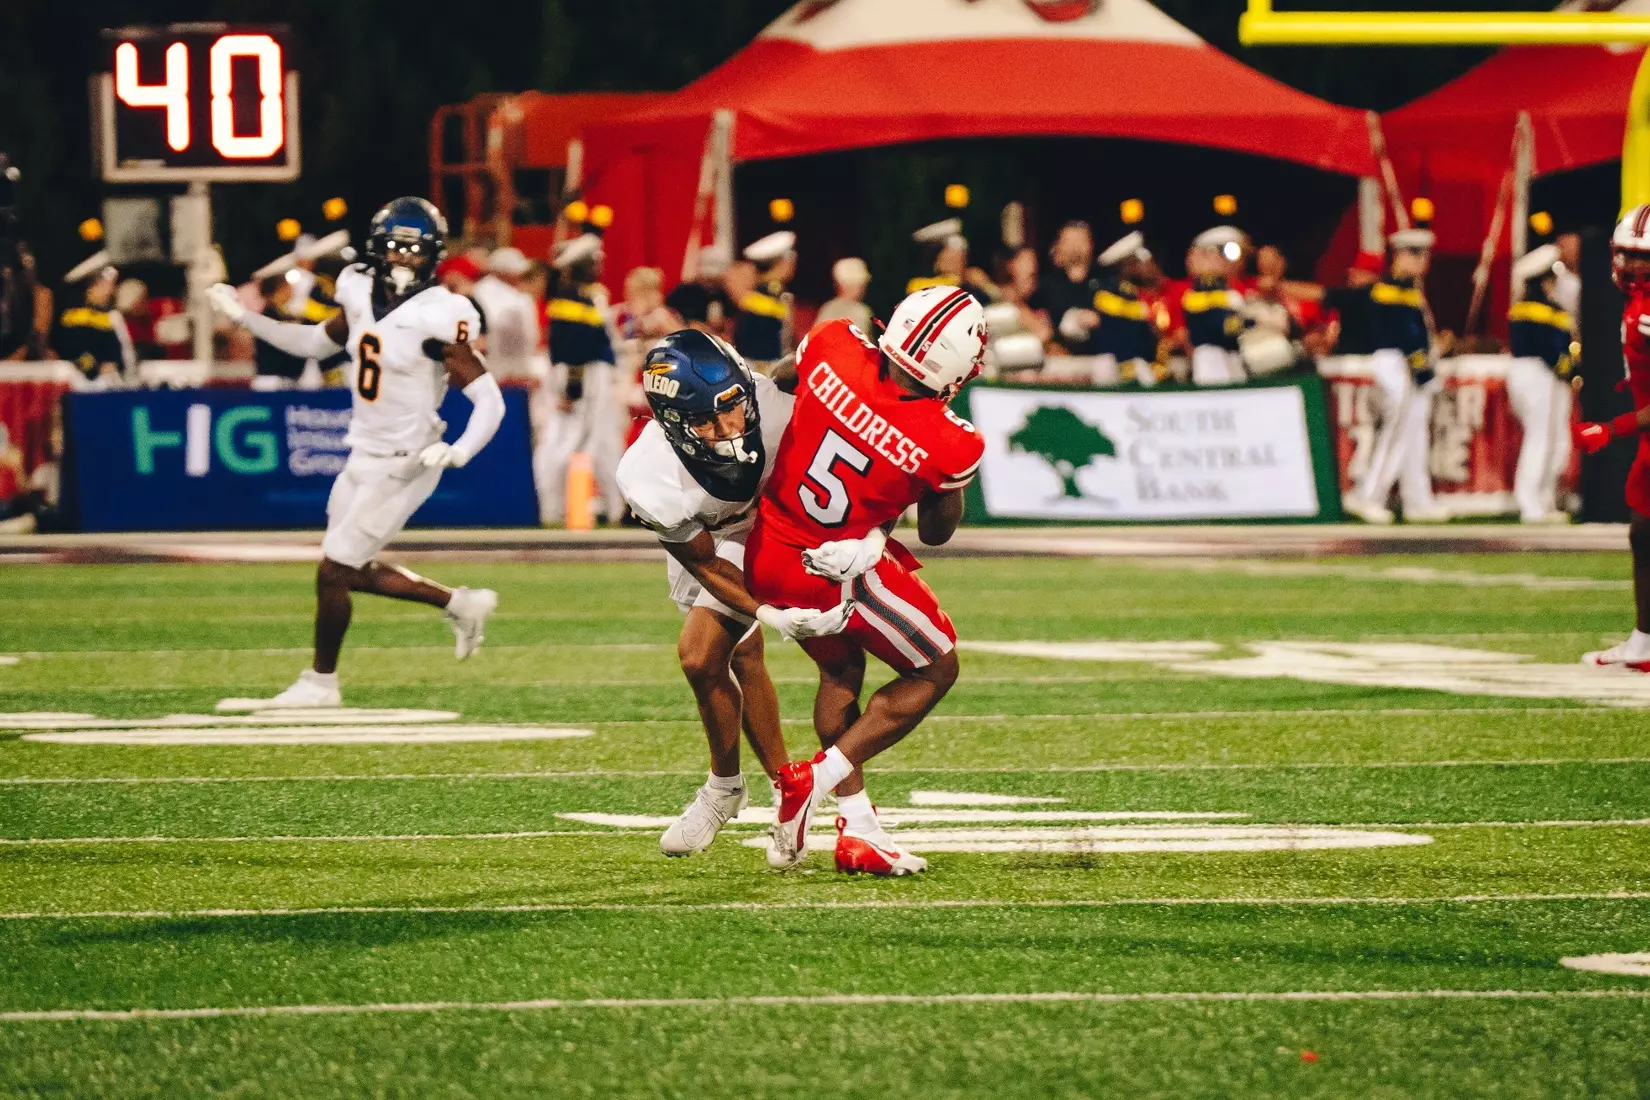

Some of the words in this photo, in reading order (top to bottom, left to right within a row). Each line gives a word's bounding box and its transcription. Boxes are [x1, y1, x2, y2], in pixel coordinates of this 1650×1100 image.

[115, 34, 284, 160] 40
[358, 332, 381, 402] 6
[455, 320, 469, 343] 6
[131, 403, 279, 477] HIG
[807, 361, 929, 474] CHILDRESS
[797, 425, 874, 529] 5
